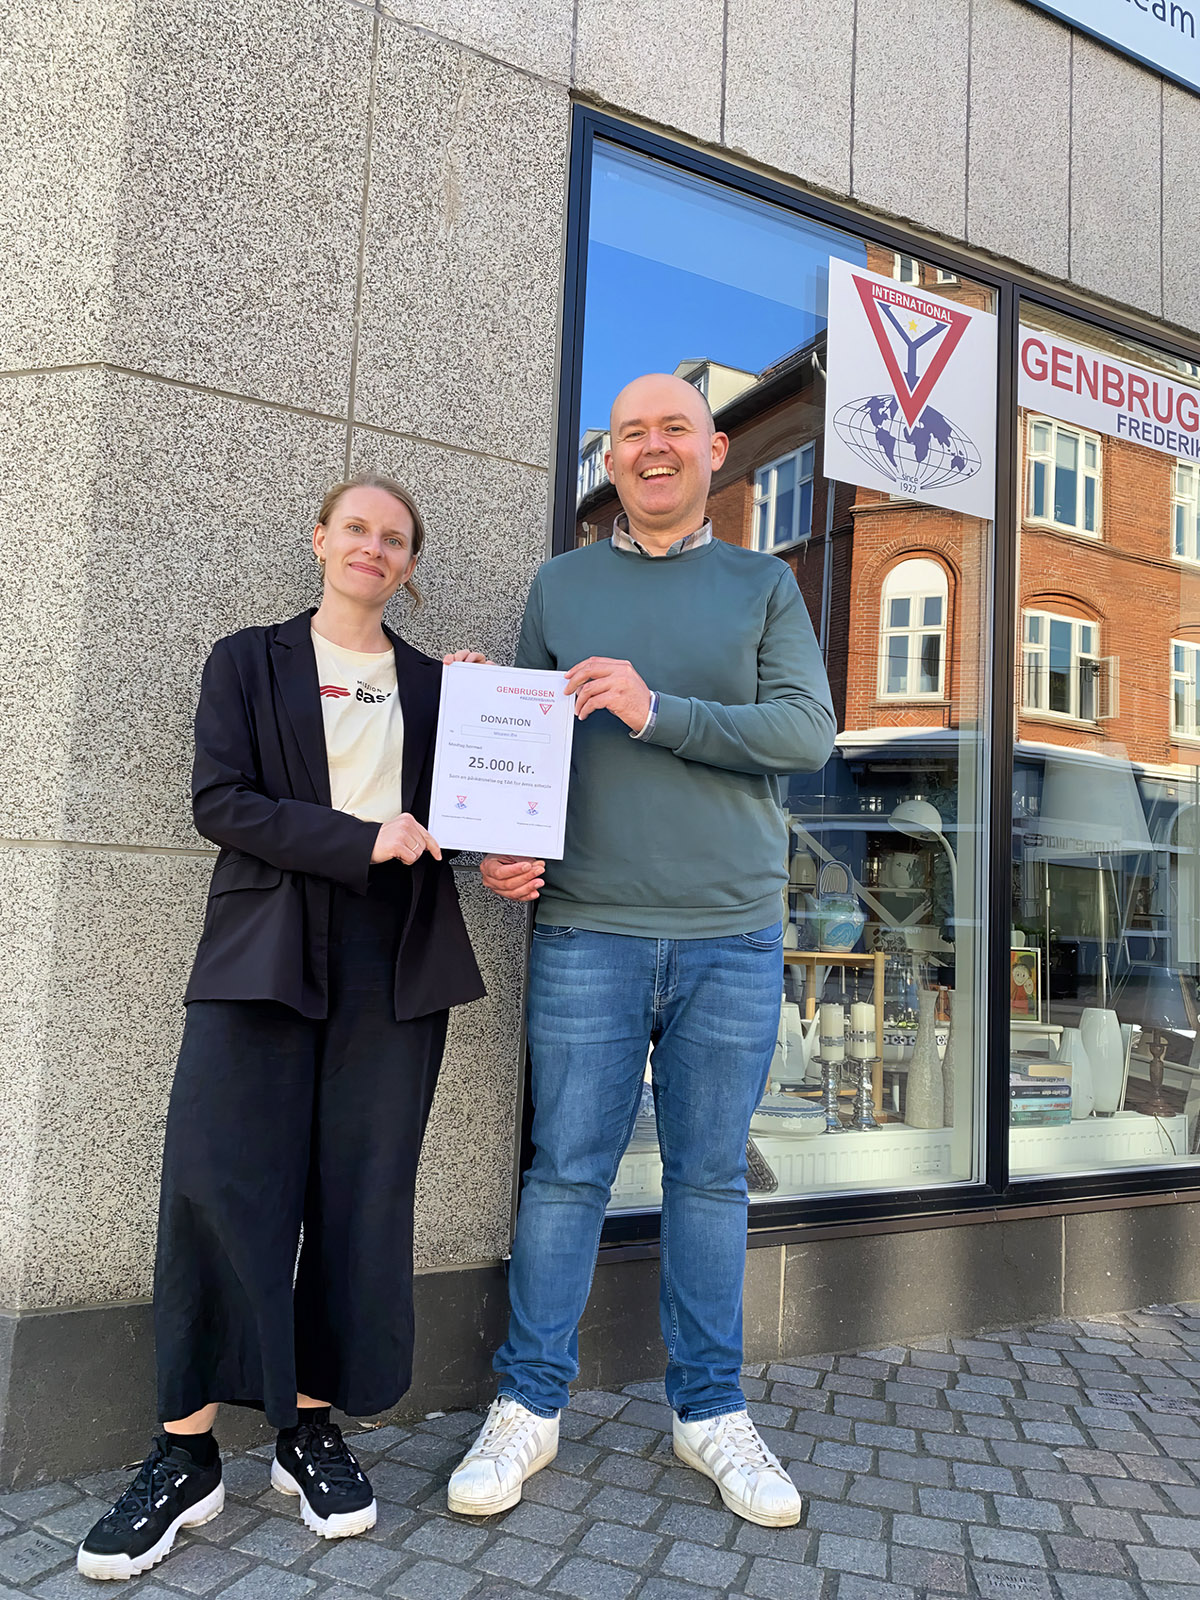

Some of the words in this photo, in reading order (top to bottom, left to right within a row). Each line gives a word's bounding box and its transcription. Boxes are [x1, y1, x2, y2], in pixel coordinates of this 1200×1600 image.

[872, 285, 953, 323] INTERNATIONAL
[1021, 338, 1199, 432] GENBRUG
[902, 473, 919, 485] since
[900, 482, 917, 494] 1922
[356, 688, 391, 704] eas
[496, 686, 555, 698] GENBRUGSEN
[480, 714, 531, 727] DONATION
[468, 756, 514, 772] 25.000
[518, 761, 535, 775] kr.
